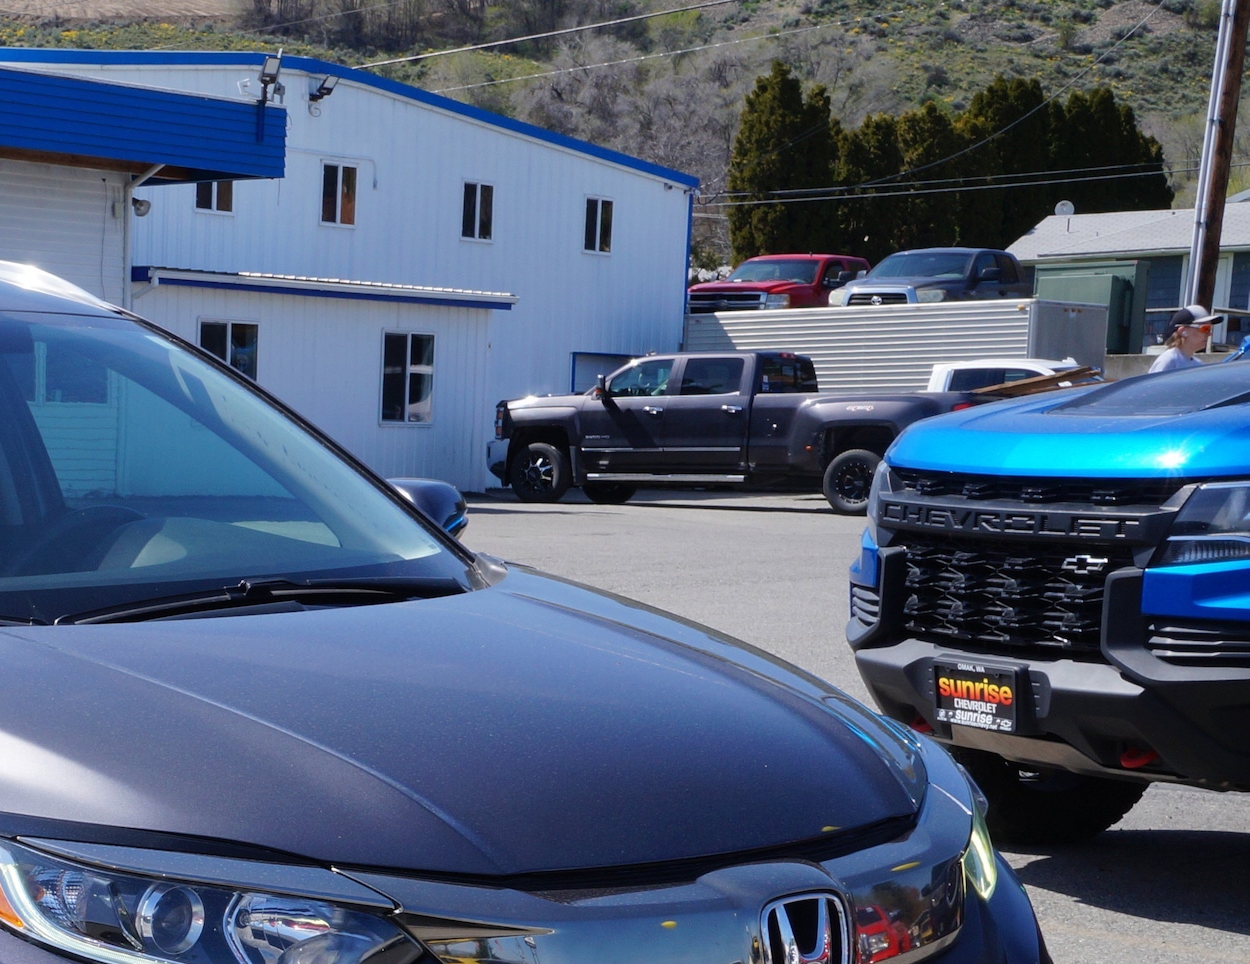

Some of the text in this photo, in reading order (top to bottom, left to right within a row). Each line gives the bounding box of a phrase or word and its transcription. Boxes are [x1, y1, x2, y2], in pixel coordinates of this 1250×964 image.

[883, 504, 1140, 538] CHEVROLET
[938, 677, 1013, 705] sunrise
[953, 697, 998, 714] CHEVROLET
[954, 709, 993, 725] sunrise
